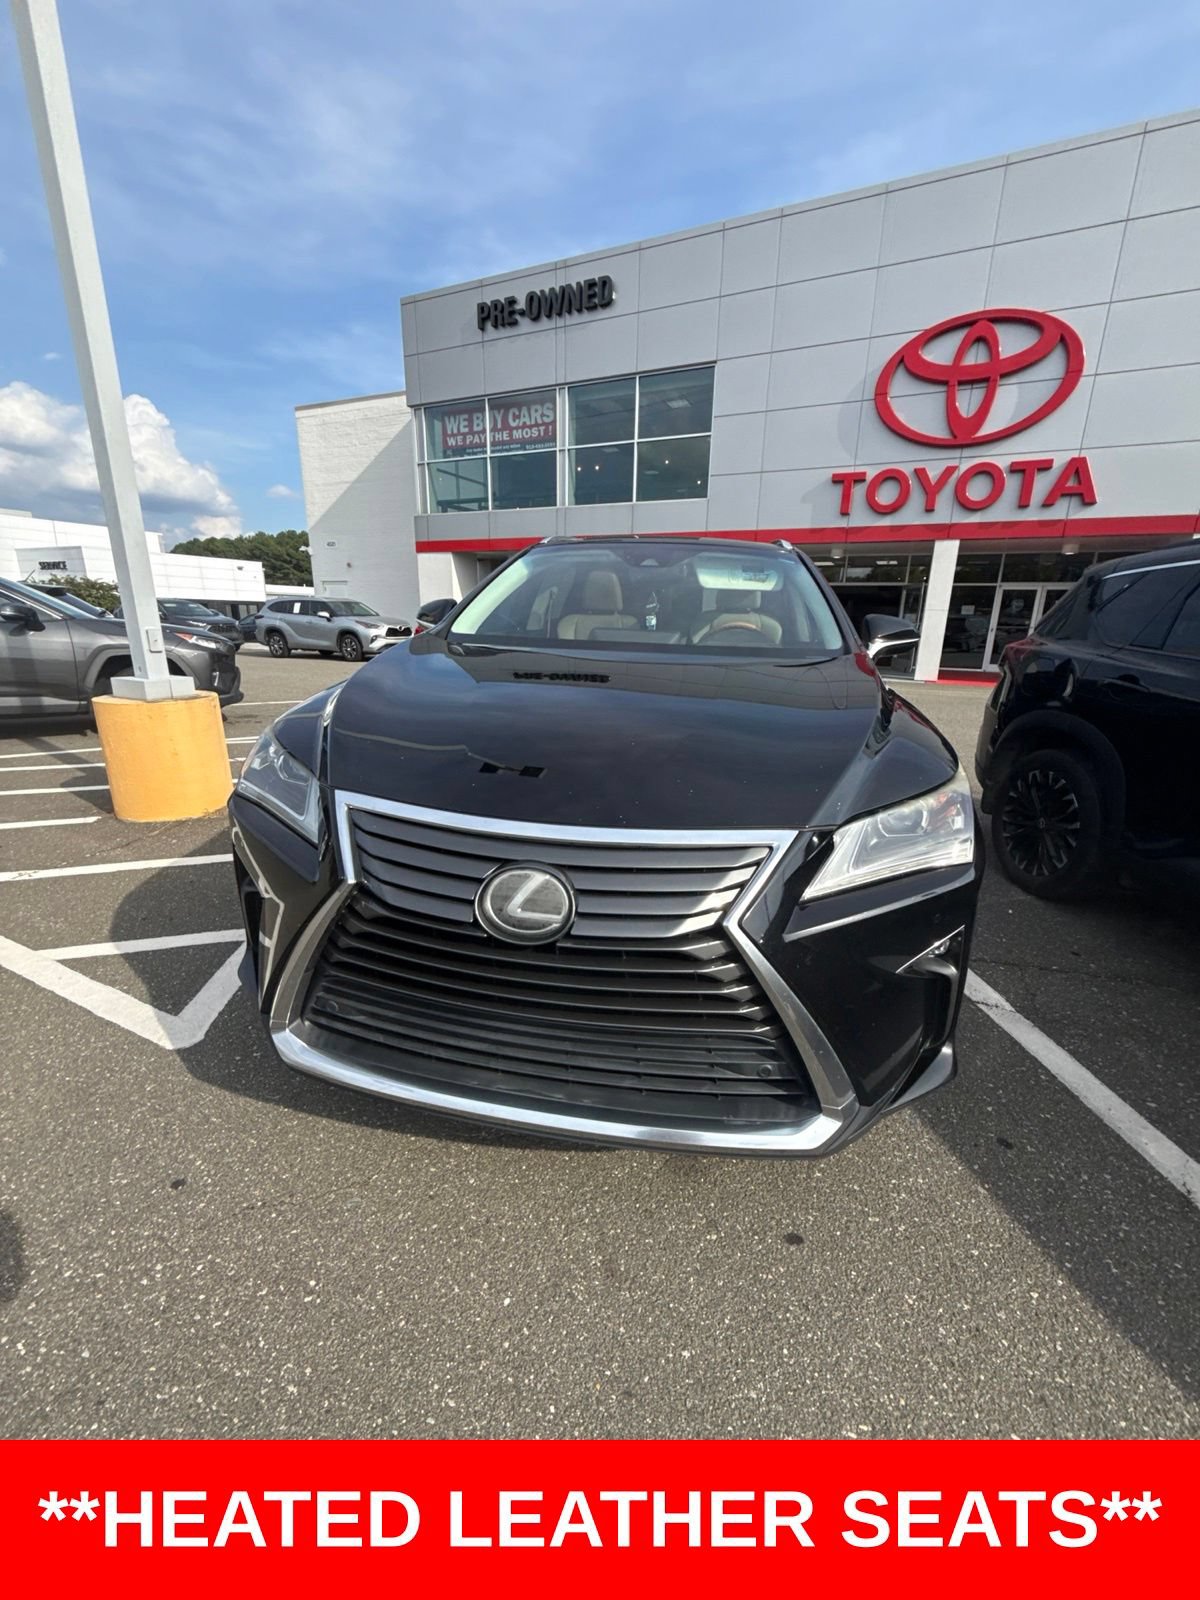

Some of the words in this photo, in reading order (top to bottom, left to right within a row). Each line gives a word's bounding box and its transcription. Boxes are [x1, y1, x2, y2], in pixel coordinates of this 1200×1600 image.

[477, 275, 615, 331] PRE-OWNED
[444, 414, 469, 435] WE
[473, 408, 505, 432] BUY
[508, 402, 554, 427] CARS
[446, 435, 464, 447] WE
[466, 432, 487, 445] PAY
[488, 430, 510, 442] THE
[512, 425, 546, 440] MOST
[832, 456, 1098, 515] TOYOTA
